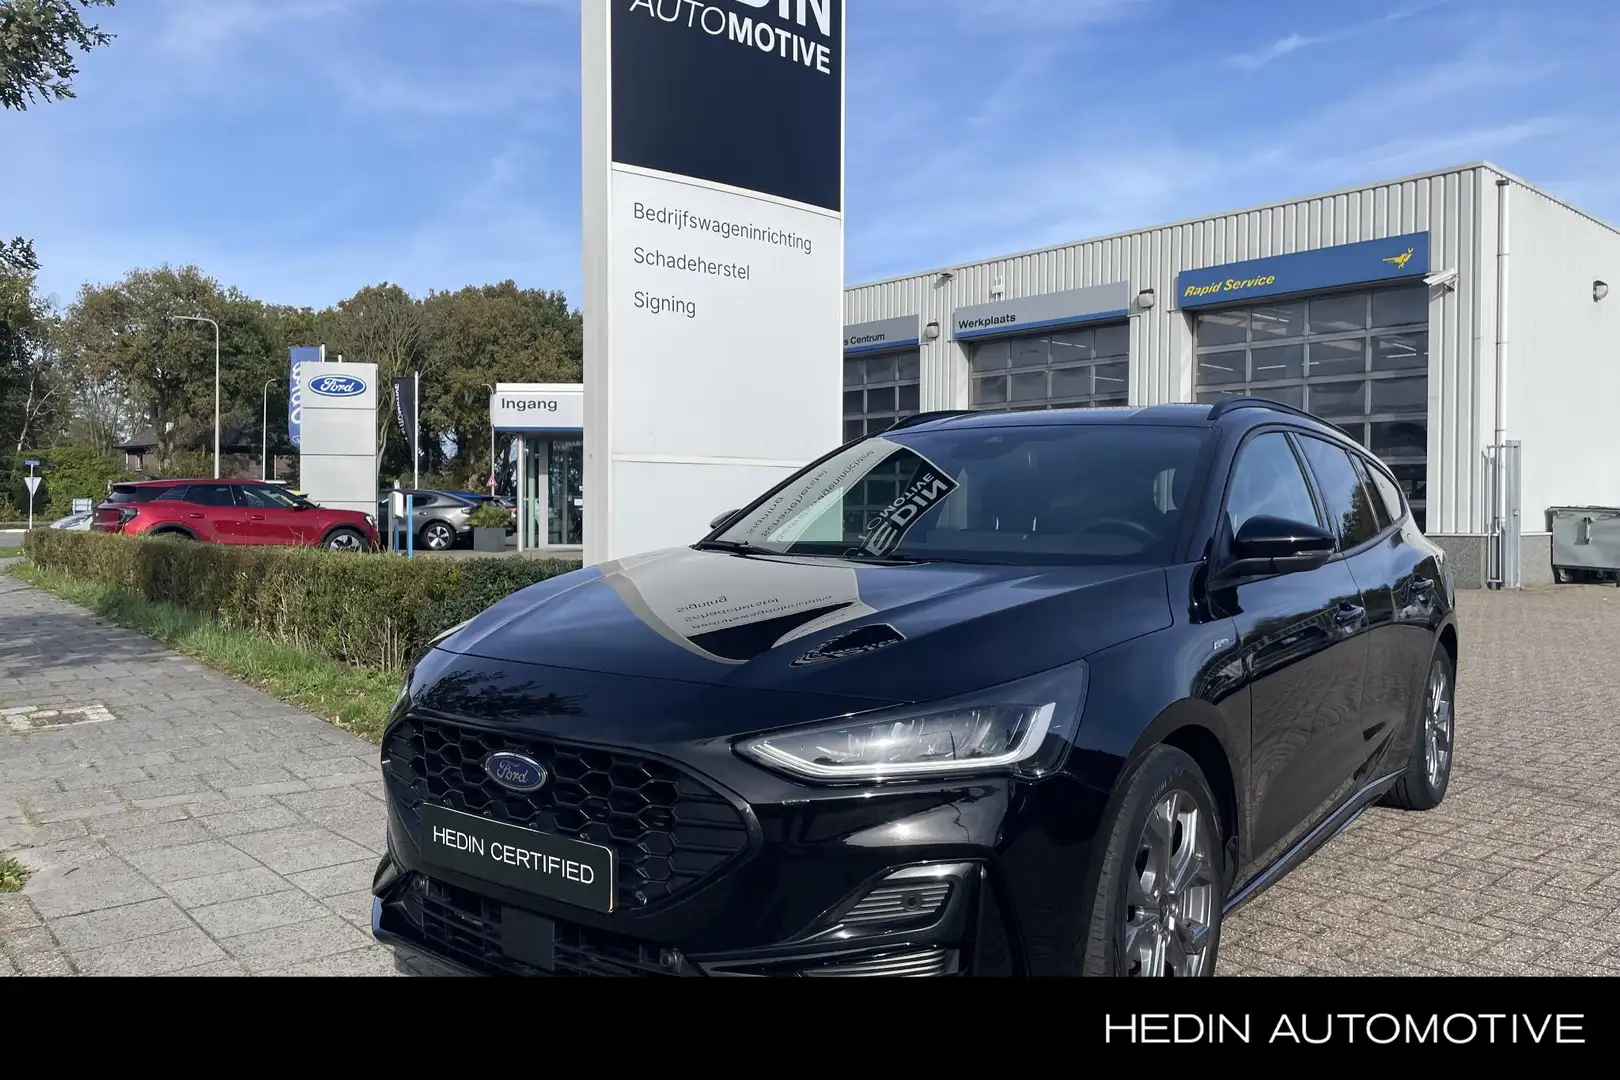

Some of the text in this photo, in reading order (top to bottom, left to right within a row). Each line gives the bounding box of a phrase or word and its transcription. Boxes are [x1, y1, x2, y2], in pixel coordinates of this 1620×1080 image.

[633, 202, 812, 255] Bedrijfswageninrichting
[633, 246, 751, 281] Schadeherstel
[1184, 275, 1275, 297] Rapid Service
[633, 291, 697, 319] Signing
[958, 313, 1016, 329] Werkplaats
[850, 333, 885, 345] Centrum
[320, 377, 356, 392] Ford
[501, 398, 558, 412] Ingang
[496, 760, 529, 784] Ford
[433, 825, 594, 884] HEDIN CERTIFIED
